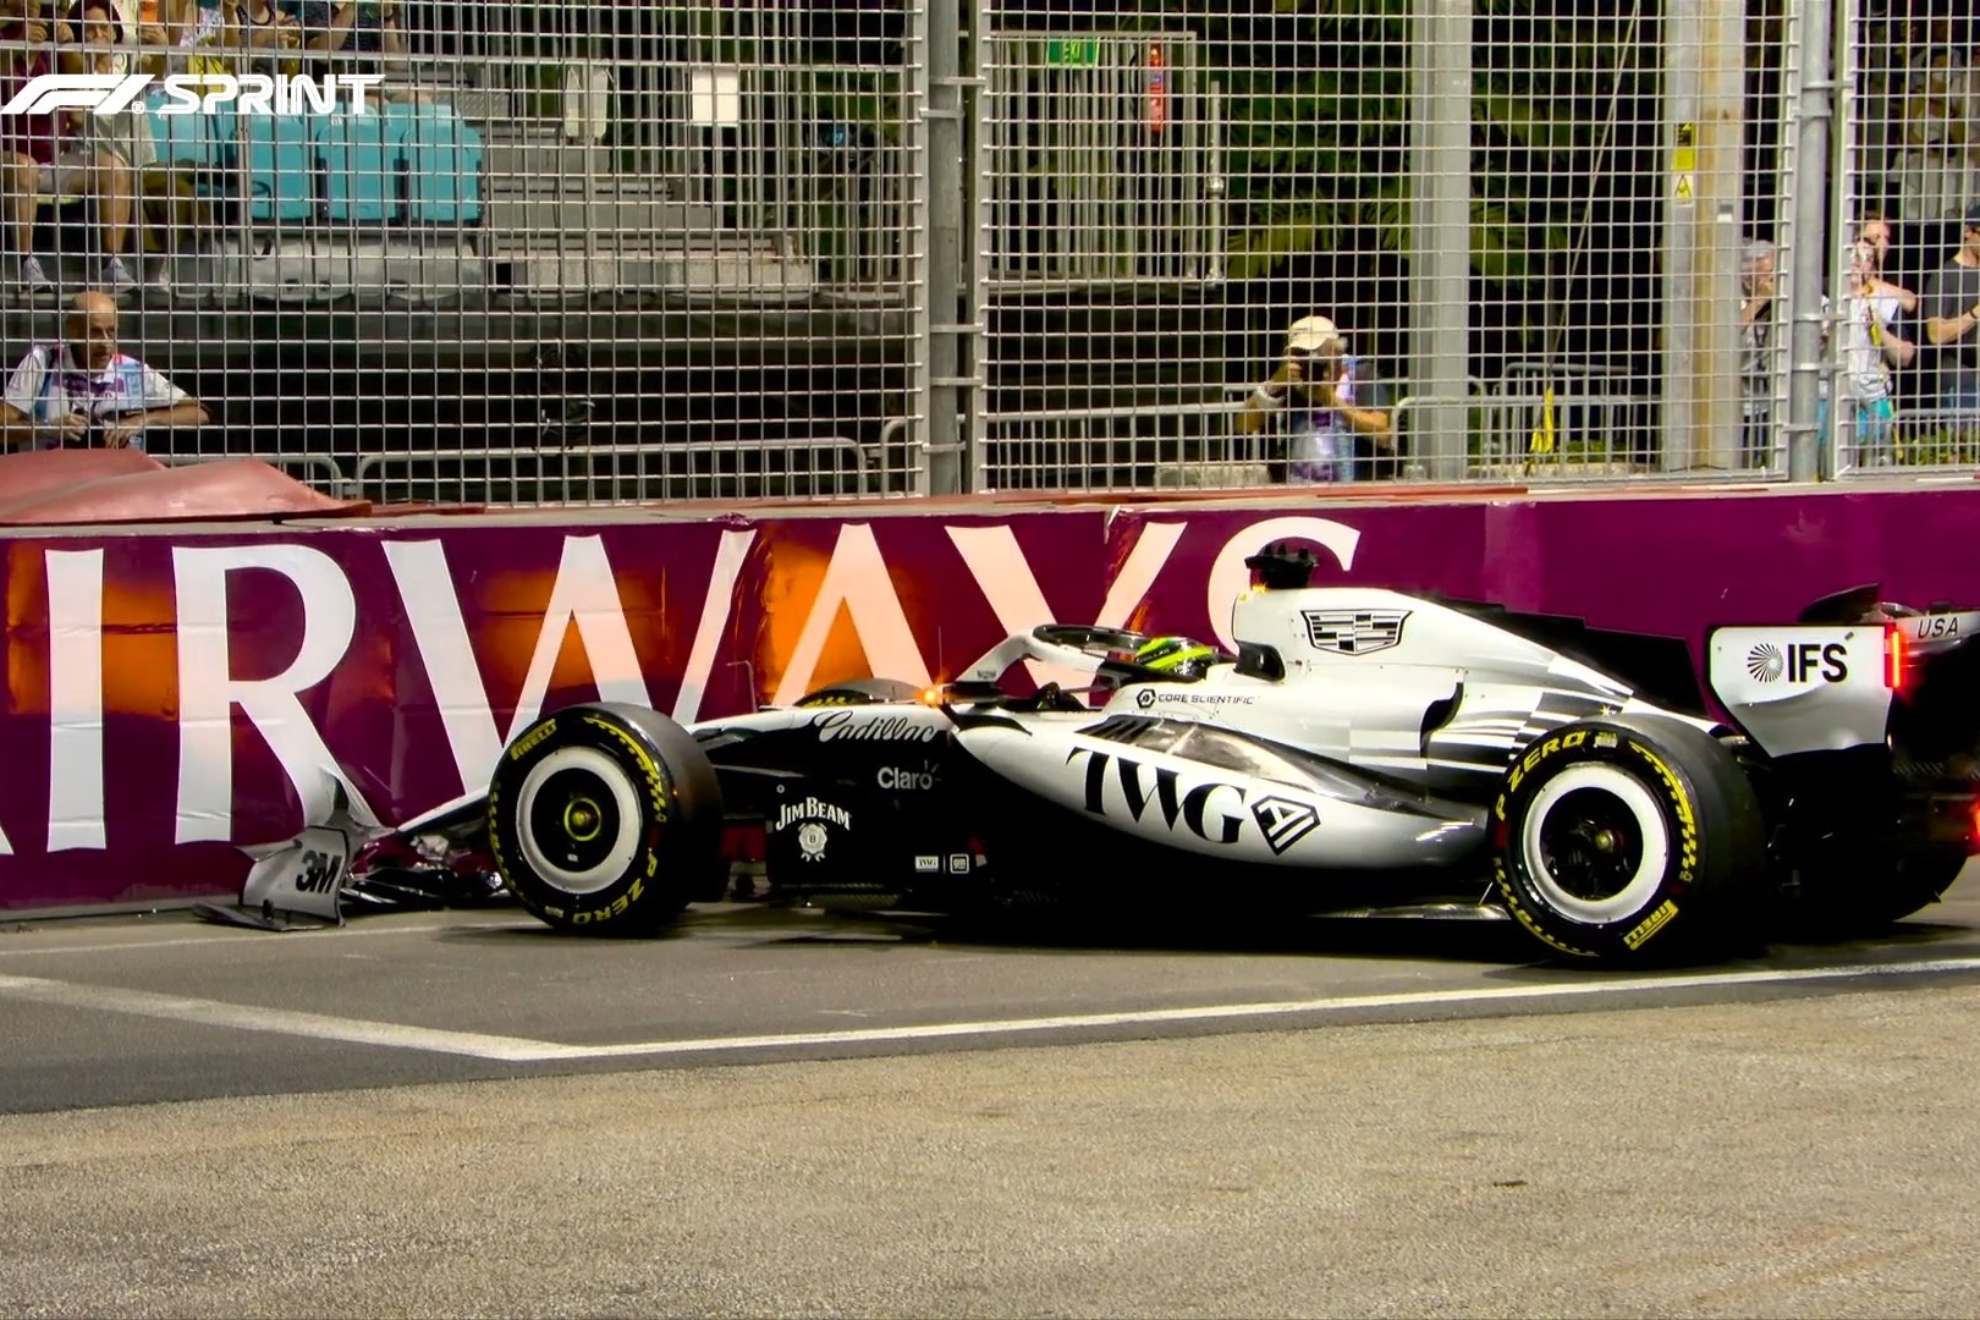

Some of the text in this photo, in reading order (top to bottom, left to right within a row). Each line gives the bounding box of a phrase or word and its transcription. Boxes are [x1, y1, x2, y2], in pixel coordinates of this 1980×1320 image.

[1918, 618, 1959, 639] USA
[1787, 643, 1848, 683] IFS
[0, 517, 1361, 858] IRWAY
[1158, 693, 1255, 705] CORE SCIENTIFIC
[509, 718, 557, 761] PIRELLI
[814, 710, 938, 743] Cadillac
[877, 764, 934, 790] Claro
[1507, 731, 1587, 793] ZERO
[775, 796, 850, 831] JIM BEAM
[1065, 746, 1247, 844] TWG
[295, 850, 342, 894] 3M
[572, 878, 645, 925] ZERO
[1623, 899, 1680, 951] PIRELLI
